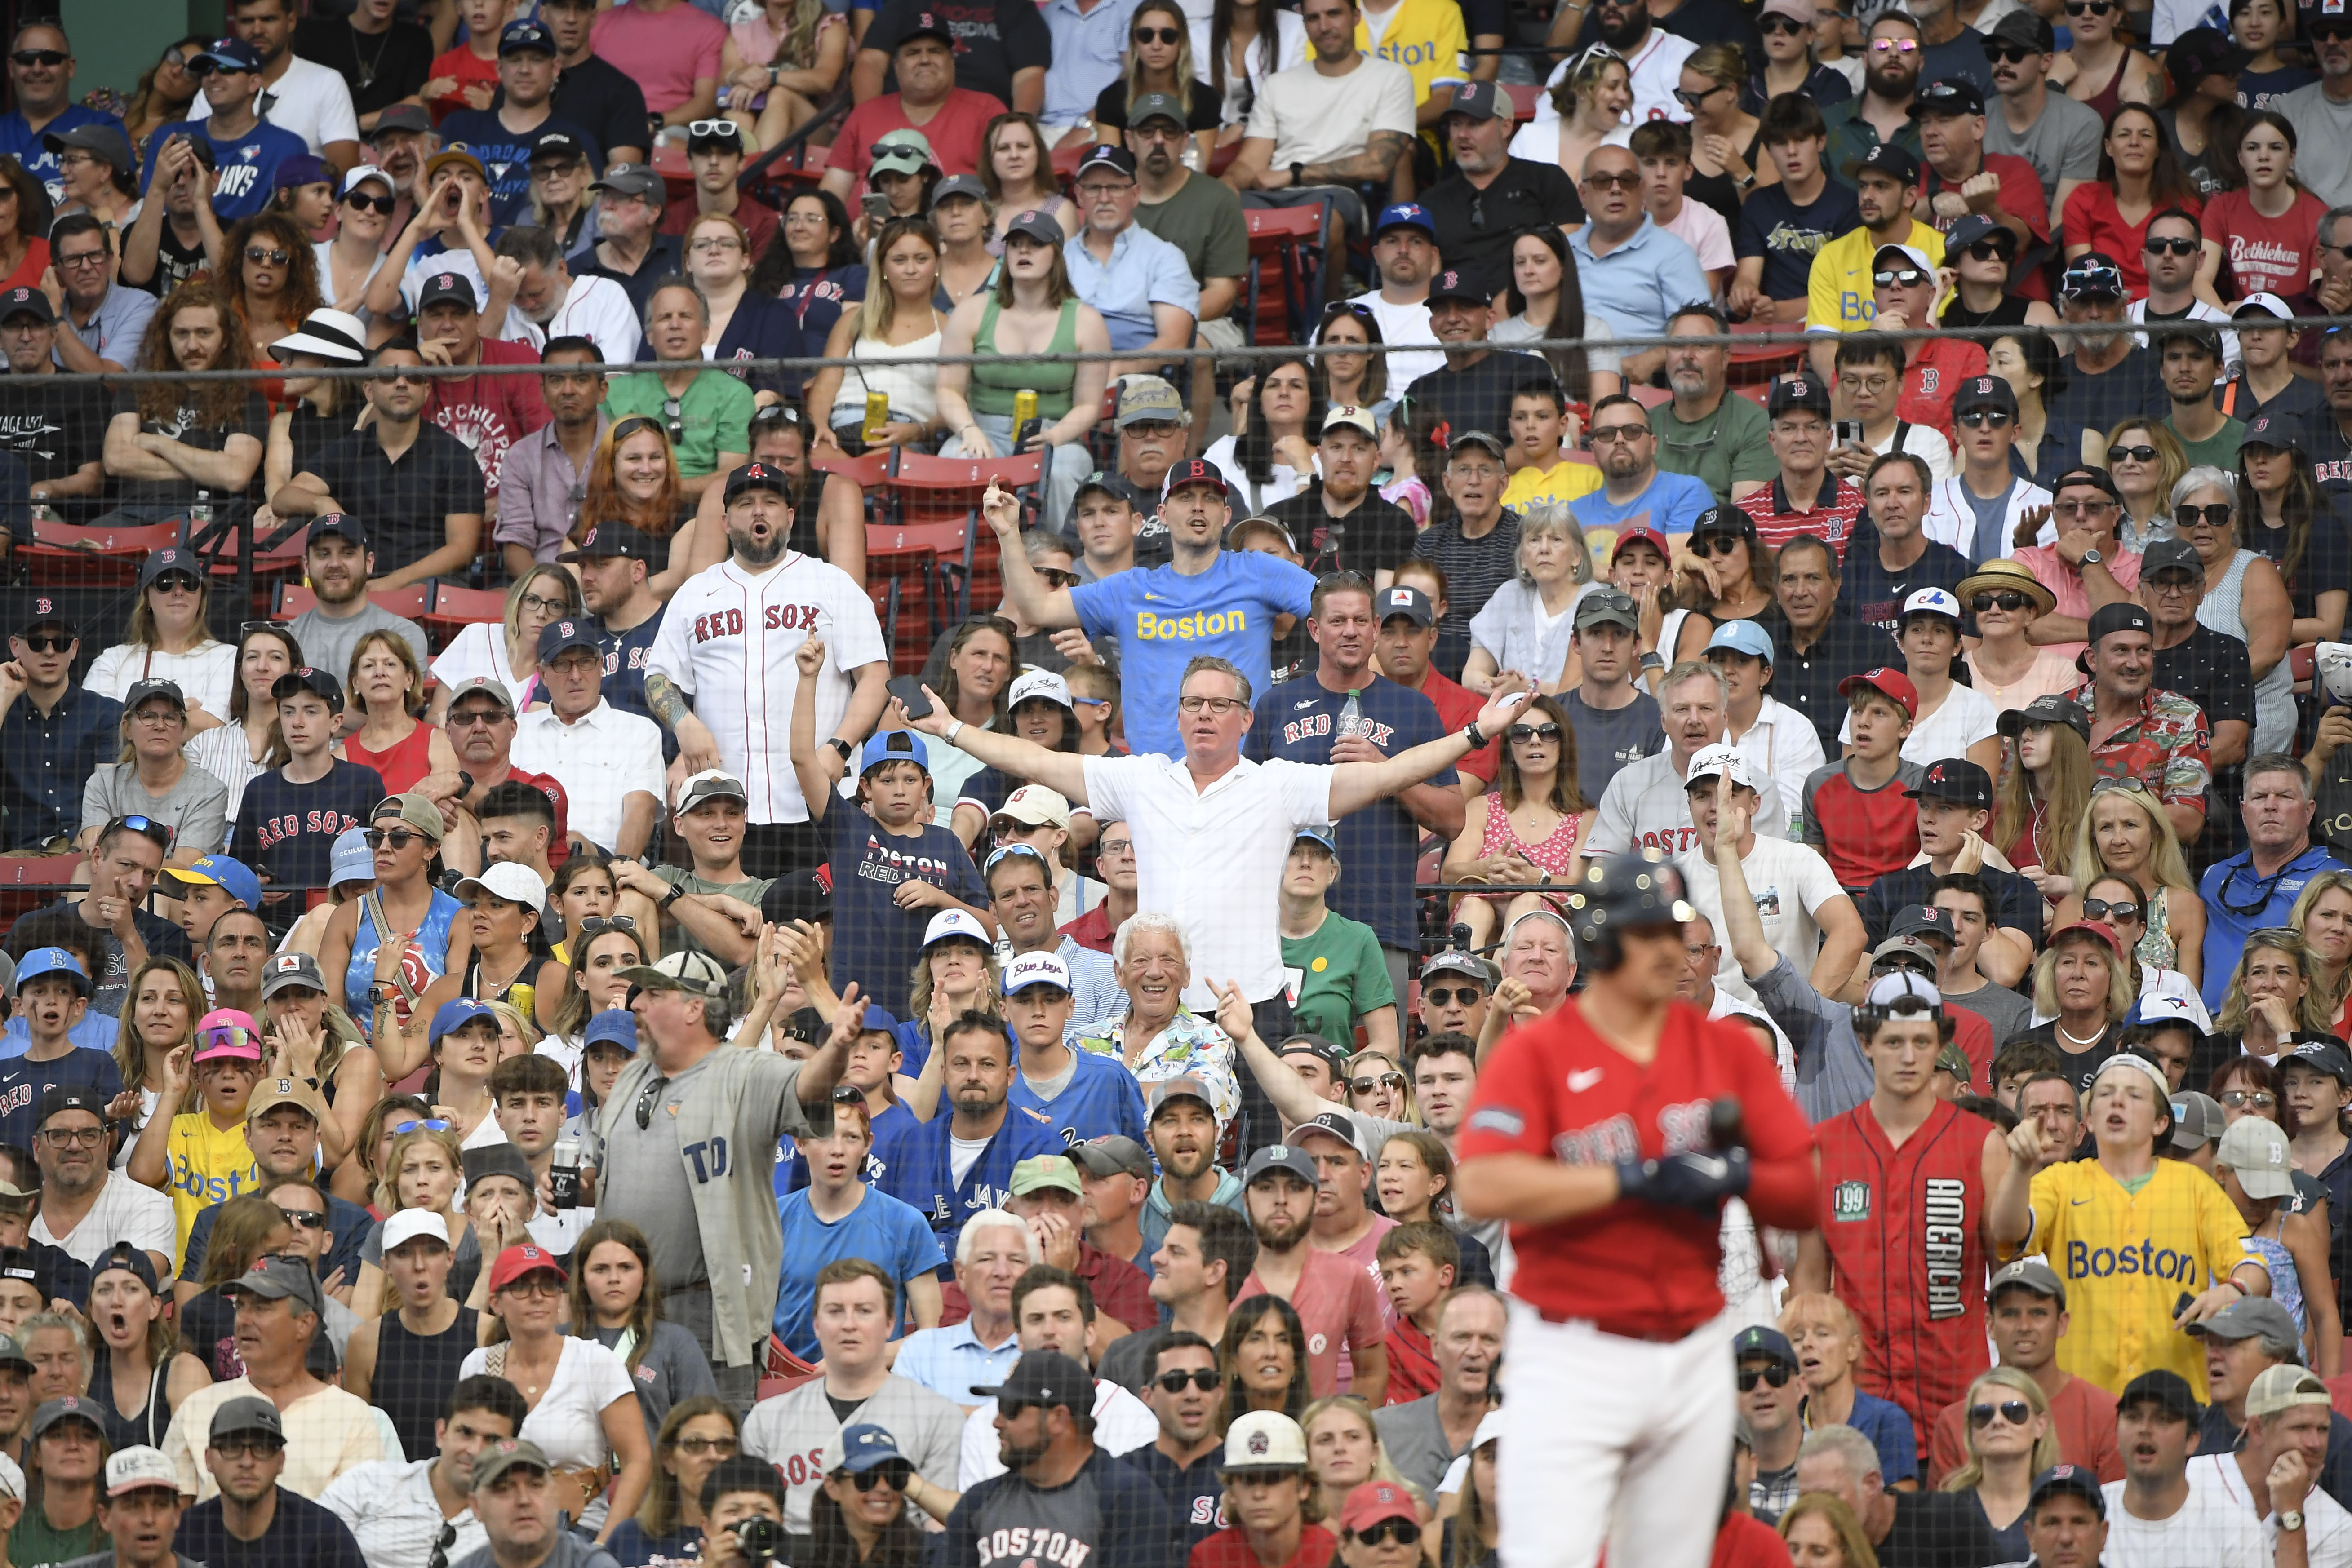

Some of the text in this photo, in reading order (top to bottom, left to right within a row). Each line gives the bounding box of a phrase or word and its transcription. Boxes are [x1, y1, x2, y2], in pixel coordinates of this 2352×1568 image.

[2229, 235, 2299, 264] Bethlehem
[439, 274, 453, 290] B
[1444, 271, 1457, 289] B
[15, 288, 29, 302] B
[2254, 293, 2262, 303] B
[1920, 369, 1938, 393] B
[1977, 377, 1993, 393] B
[1792, 382, 1806, 397] B
[1342, 406, 1355, 416] B
[455, 403, 505, 436] CHILI
[2254, 418, 2269, 431] B
[1189, 461, 1205, 477] B
[326, 514, 340, 525] B
[1704, 509, 1717, 524] B
[584, 527, 597, 545] B
[1828, 518, 1842, 539] B
[162, 549, 175, 563] B
[37, 598, 51, 613] B
[559, 622, 575, 637] B
[694, 604, 821, 643] RED SOX
[1138, 610, 1246, 640] Boston
[1284, 713, 1394, 747] RED SOX
[1011, 790, 1027, 802] B
[257, 811, 359, 851] RED SOX
[339, 846, 367, 857] OCULUS
[858, 860, 902, 884] RED
[1923, 907, 1937, 921] B
[50, 952, 67, 967] B
[276, 1079, 291, 1094] B
[0, 1083, 32, 1118] RED
[683, 1136, 733, 1183] TO
[1270, 1145, 1288, 1160] B
[2269, 1142, 2282, 1163] B
[2067, 1238, 2196, 1285] Boston
[977, 1528, 1090, 1566] BOSTON
